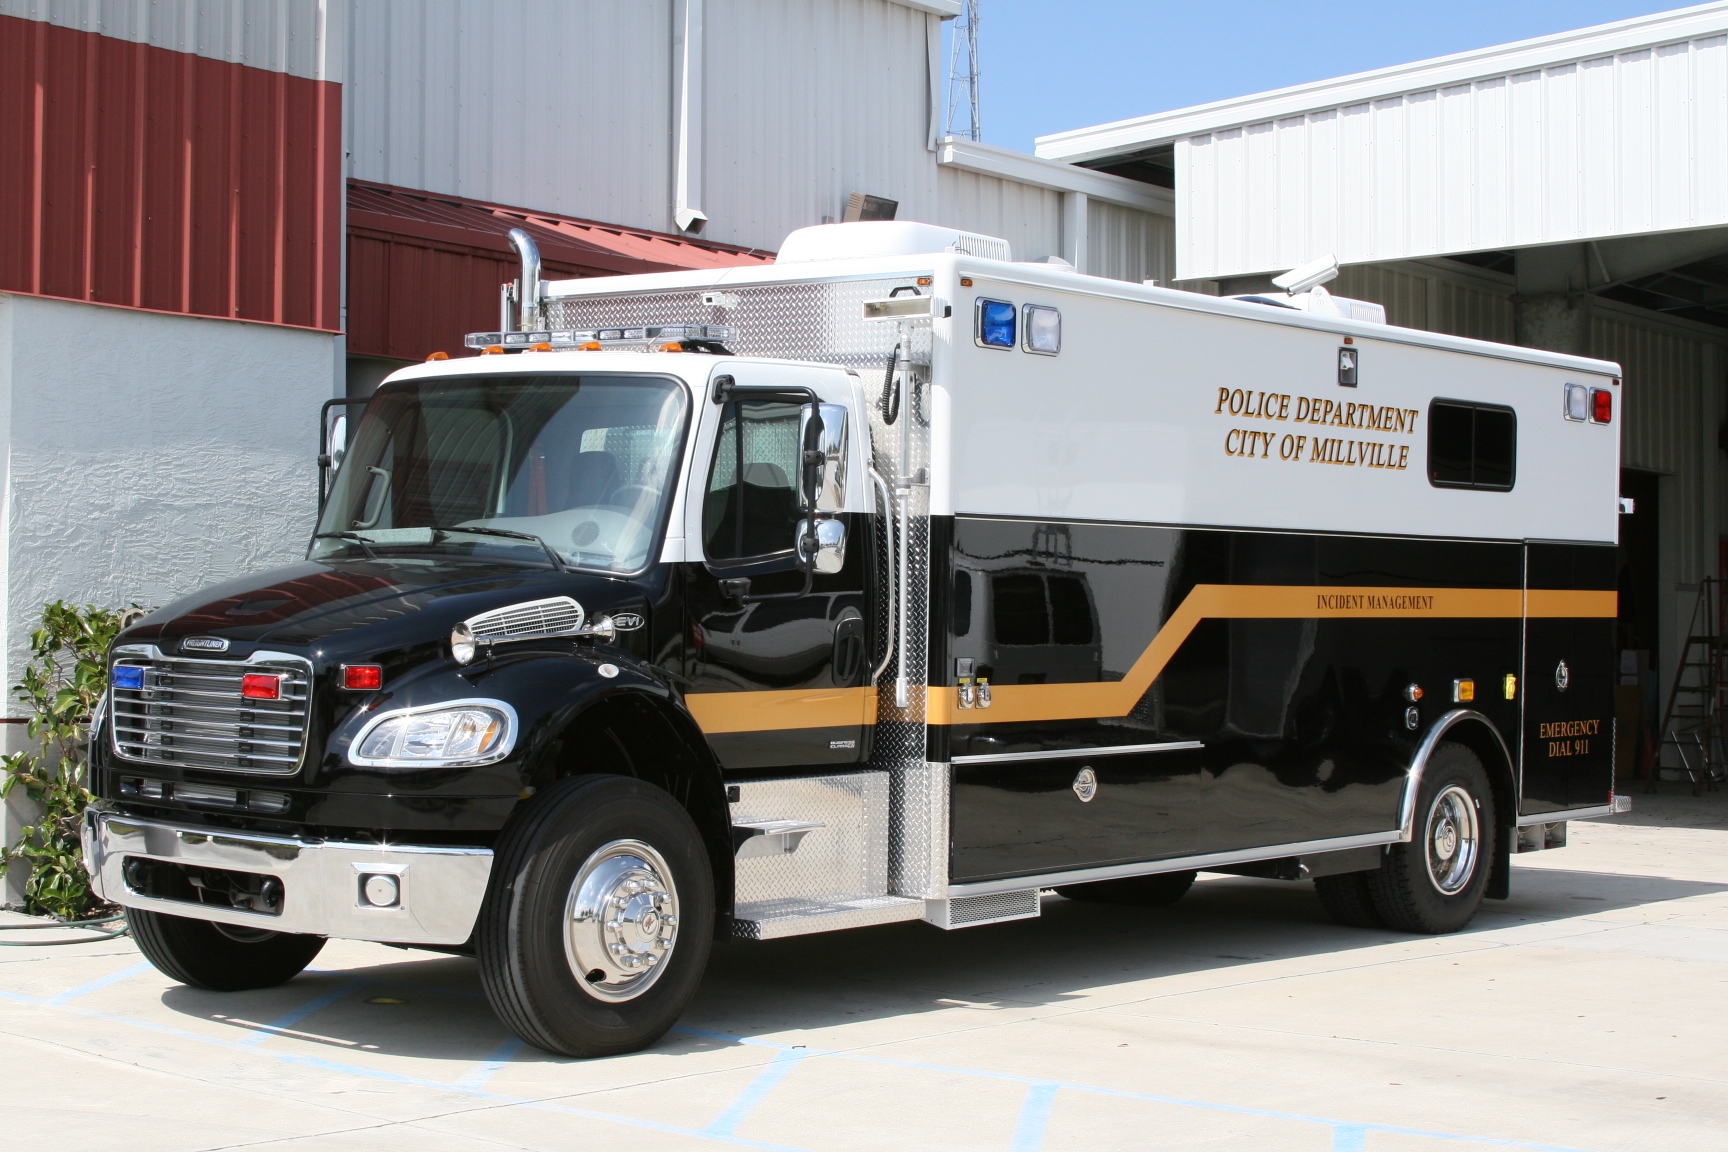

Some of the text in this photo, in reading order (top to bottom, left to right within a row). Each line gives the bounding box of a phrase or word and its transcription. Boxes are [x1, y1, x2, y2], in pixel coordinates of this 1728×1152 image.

[1214, 387, 1419, 434] POLICE DEPARTMENT
[1224, 428, 1410, 470] CITY OF MILLVILLE
[1316, 594, 1434, 610] INCIDENT MANAGEMENT
[1540, 719, 1600, 739] EMERGENCY
[1548, 739, 1589, 757] DIAL 911
